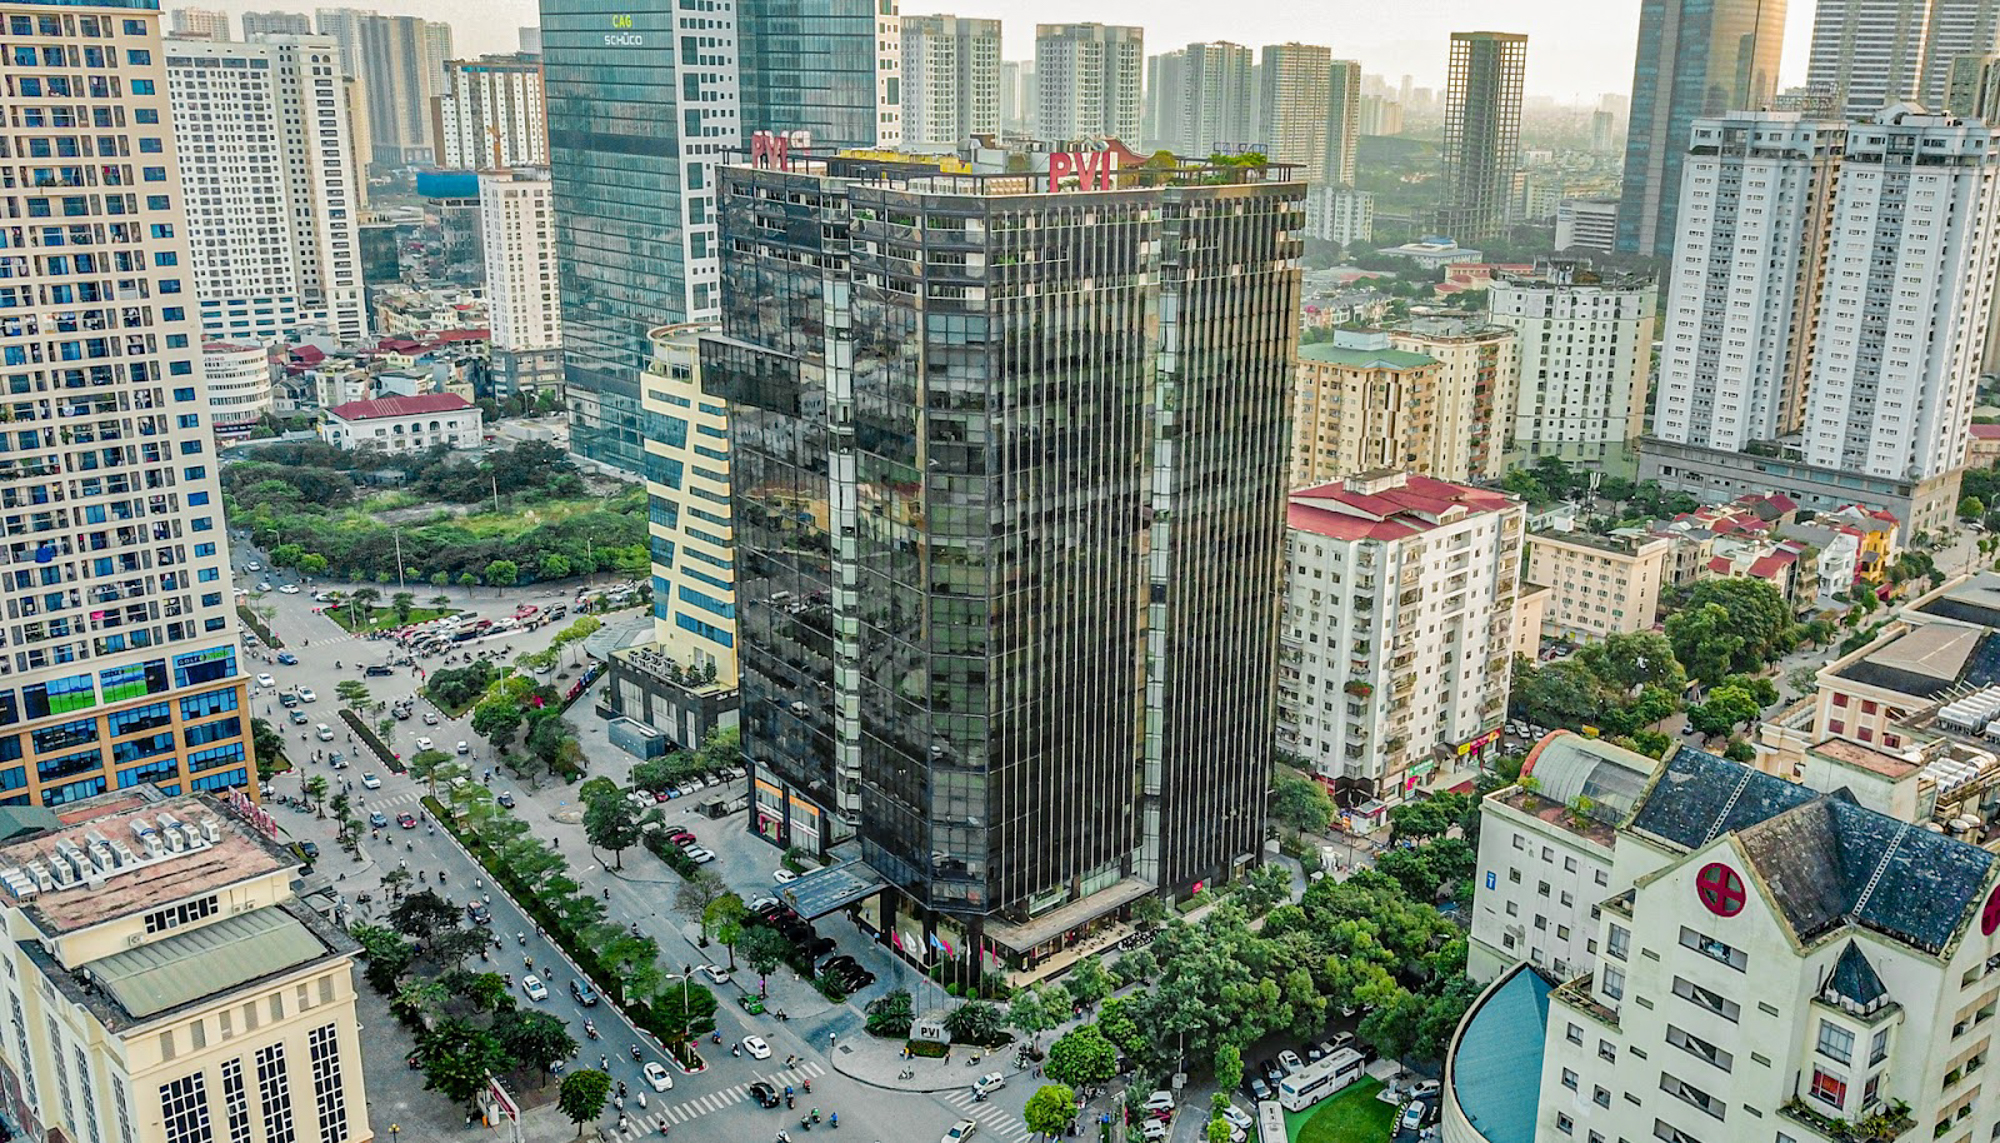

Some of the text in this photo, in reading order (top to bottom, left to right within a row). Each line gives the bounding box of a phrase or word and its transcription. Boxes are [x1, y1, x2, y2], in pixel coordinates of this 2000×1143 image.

[612, 14, 632, 28] CAG
[604, 32, 643, 46] SCHÜCO
[752, 135, 787, 172] PVI
[1050, 152, 1111, 193] PVI
[921, 1026, 940, 1039] PVI
